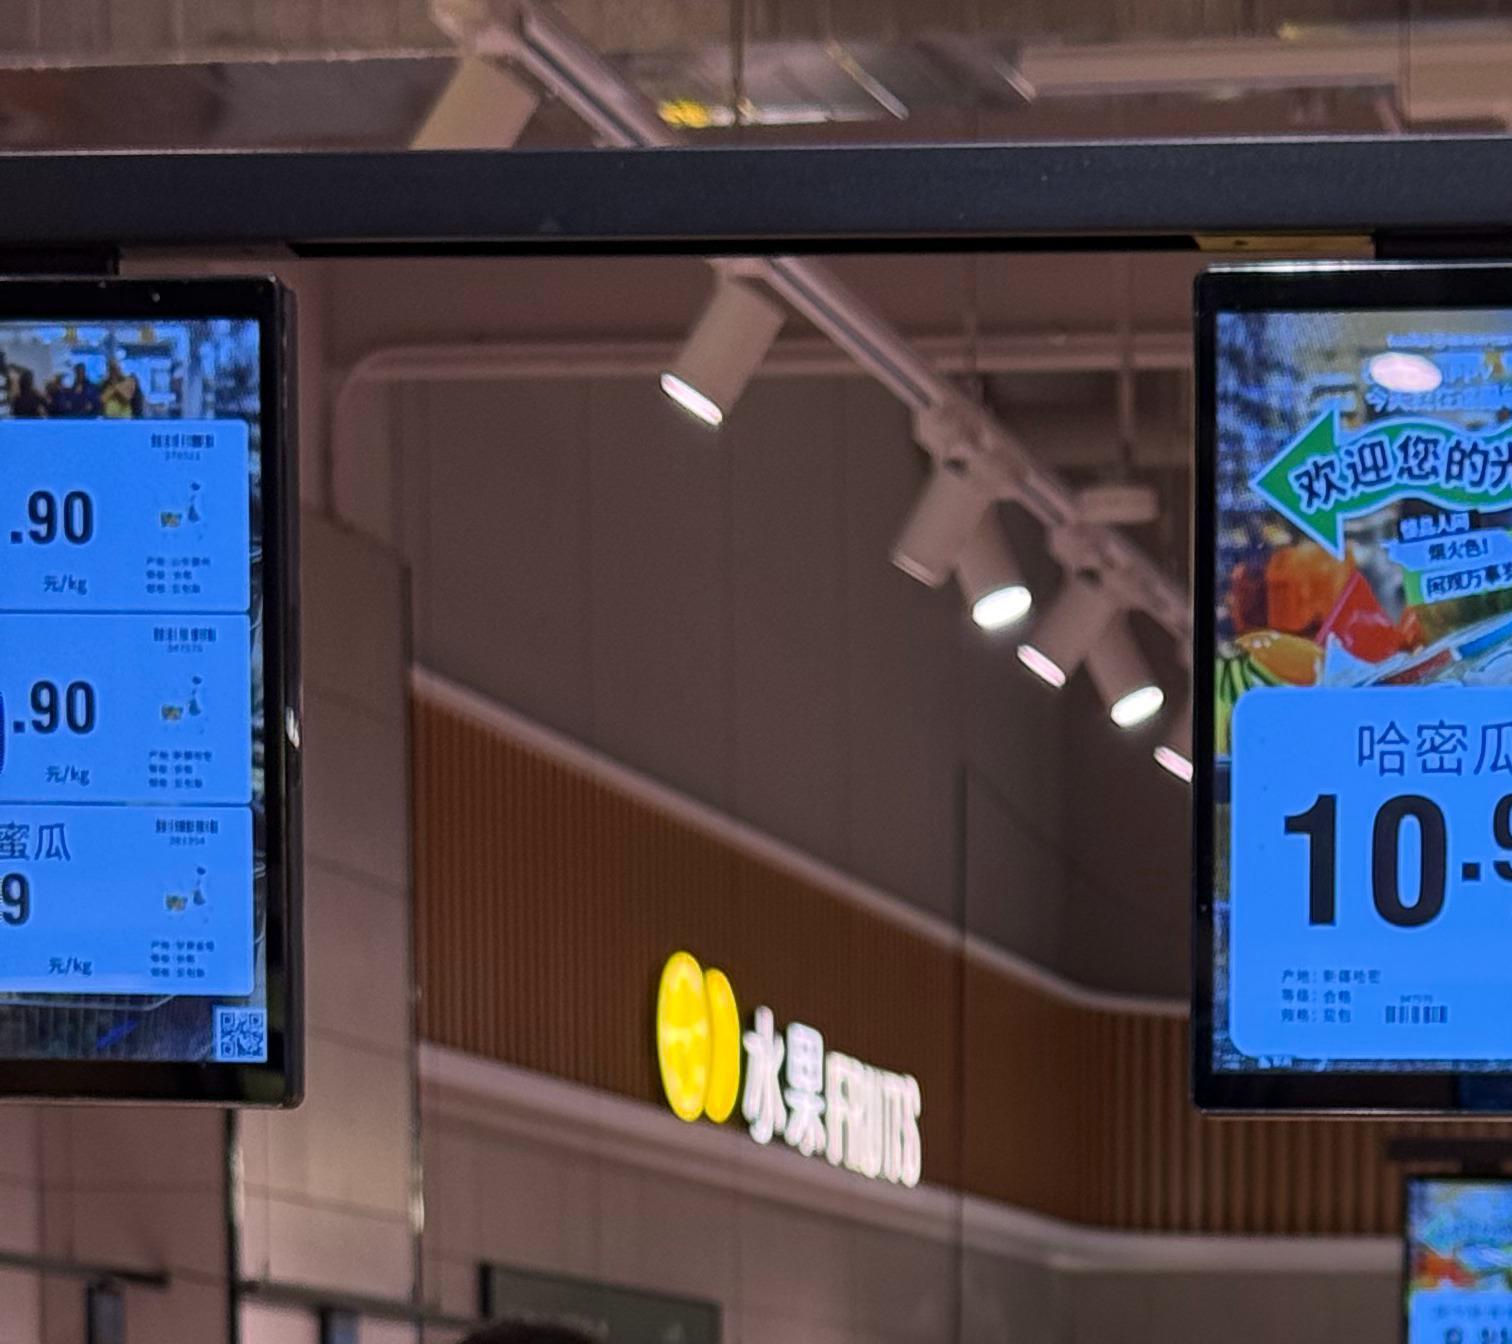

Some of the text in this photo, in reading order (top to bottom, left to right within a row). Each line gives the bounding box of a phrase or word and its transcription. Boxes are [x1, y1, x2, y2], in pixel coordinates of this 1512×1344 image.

[43, 574, 88, 595] 元/kg
[45, 765, 90, 787] 元/kg
[49, 956, 93, 977] 元/kg
[743, 1005, 826, 1157] 水果
